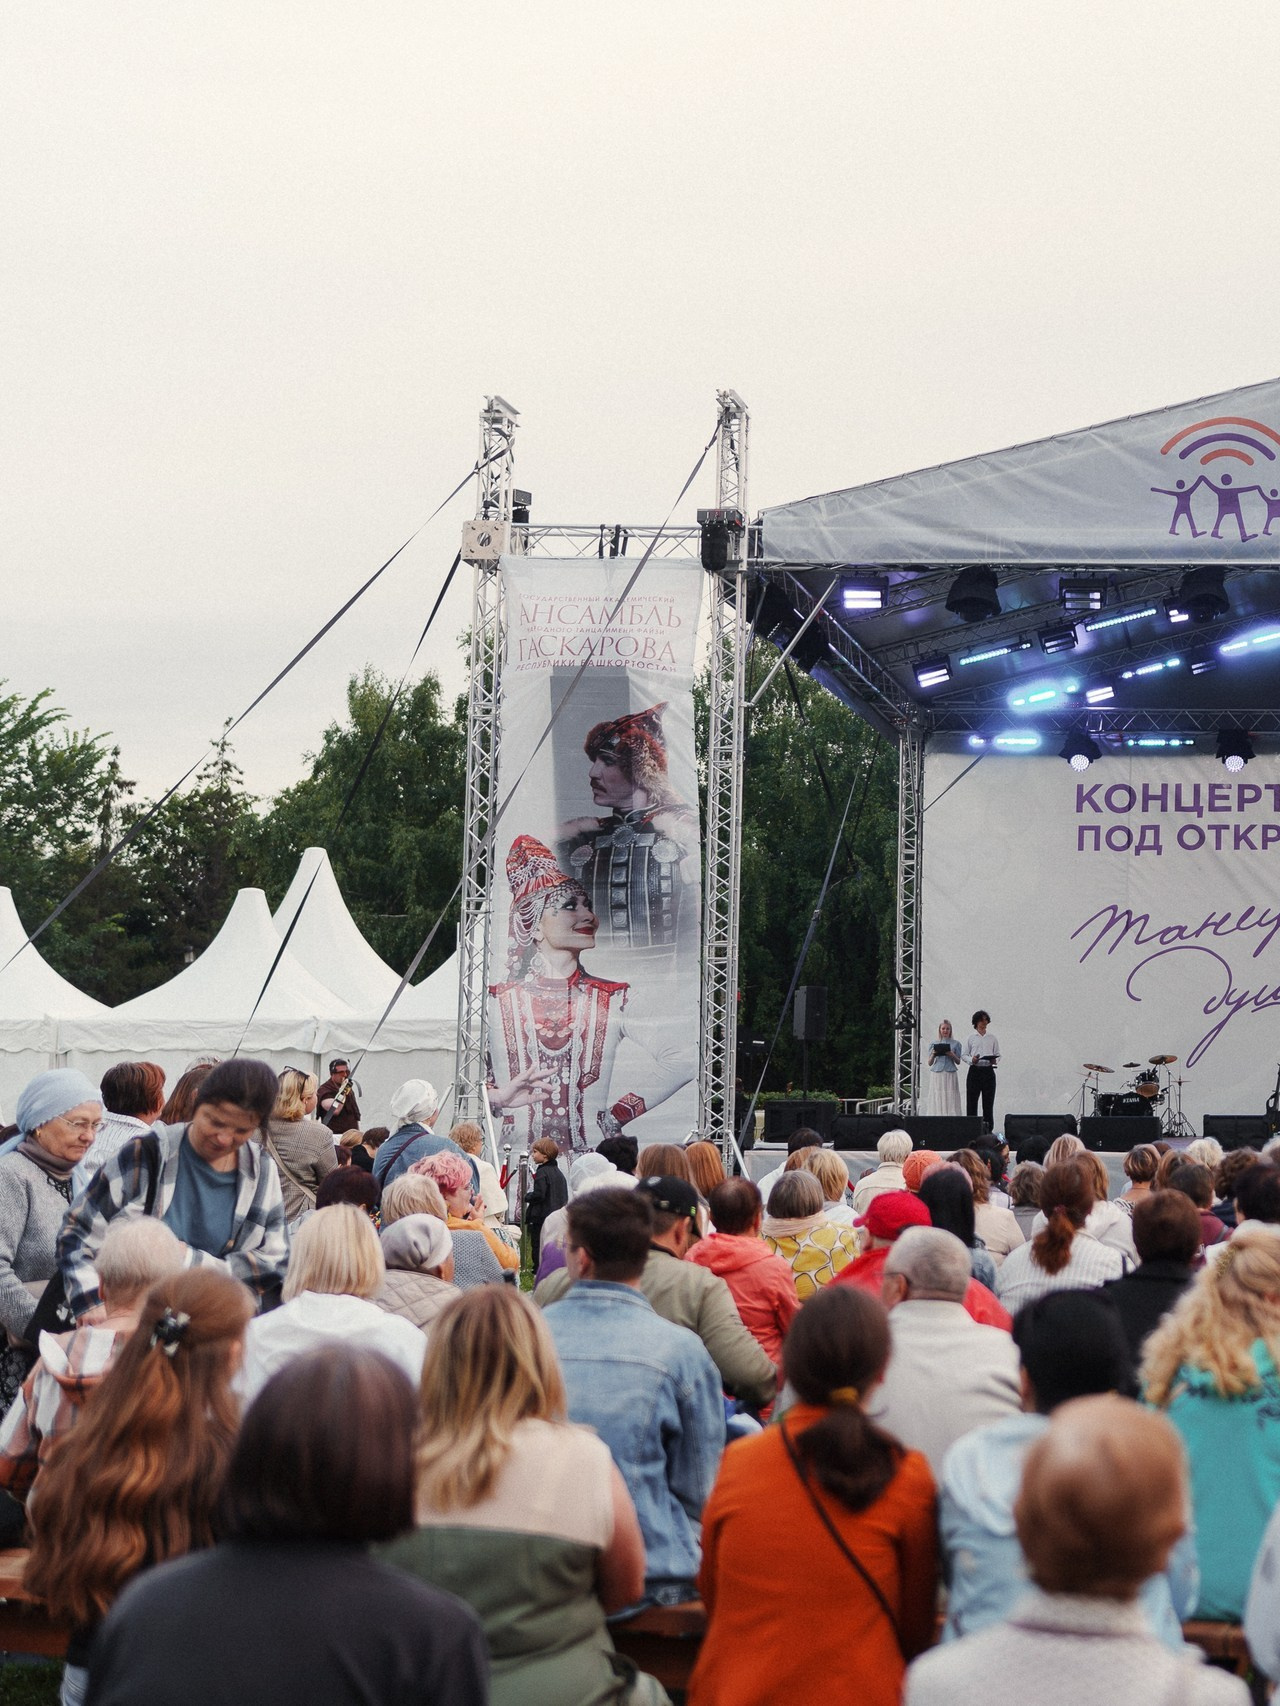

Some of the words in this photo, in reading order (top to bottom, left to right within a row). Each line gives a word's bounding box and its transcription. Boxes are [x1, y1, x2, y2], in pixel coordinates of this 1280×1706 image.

[604, 595, 675, 604] АКАЕМИЧЕСКИЙ
[519, 602, 682, 629] АНСАМБЛЬ
[519, 634, 677, 664] ГАСКАРОВА
[515, 659, 576, 672] РЕСПУБЛИКИ
[580, 659, 677, 673] БАШКОРТОСТАН
[1076, 824, 1164, 856] ПОД
